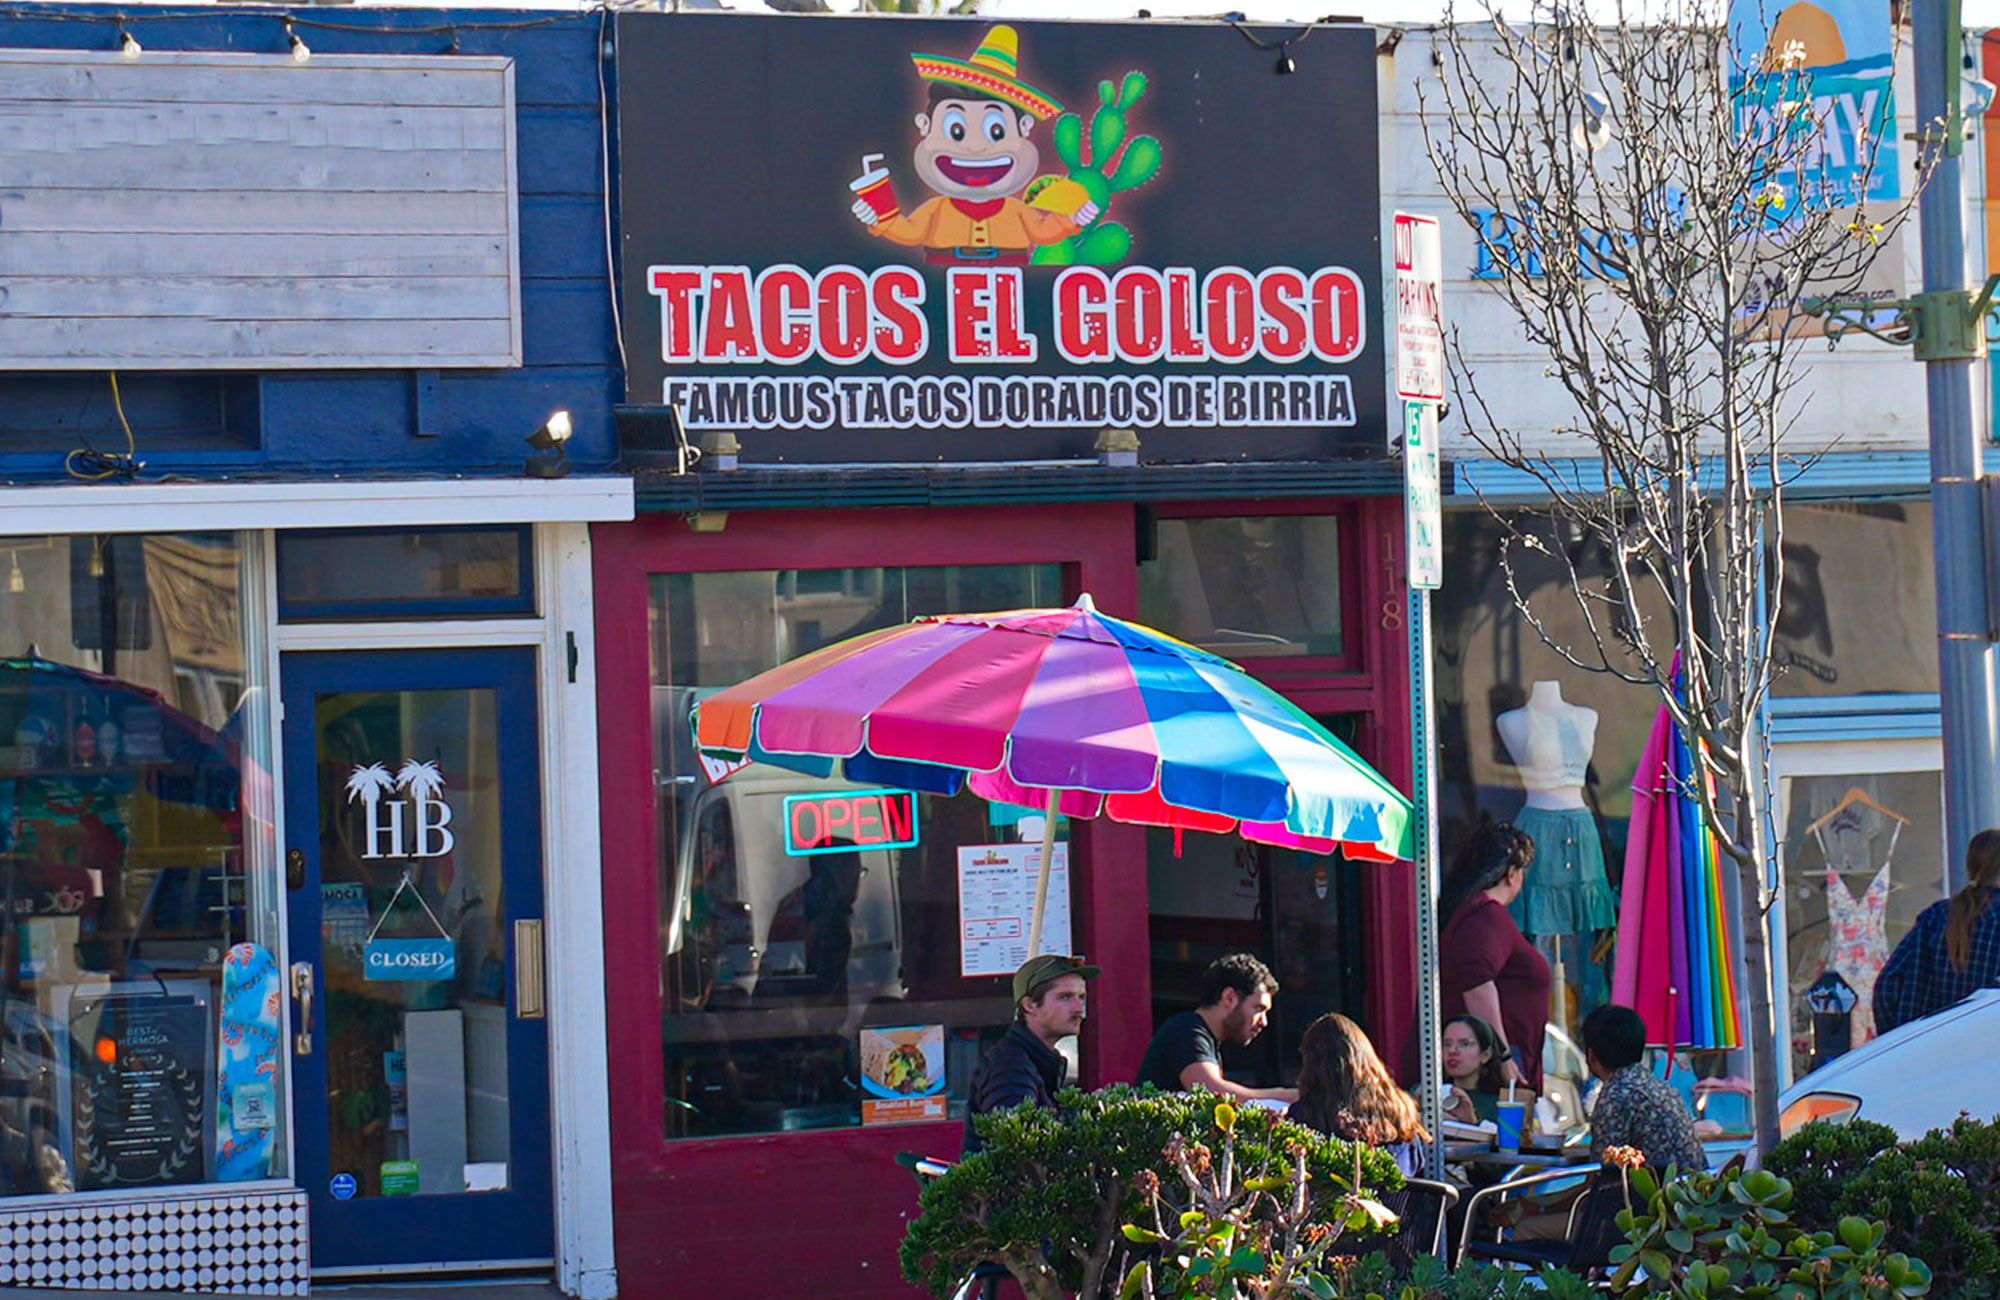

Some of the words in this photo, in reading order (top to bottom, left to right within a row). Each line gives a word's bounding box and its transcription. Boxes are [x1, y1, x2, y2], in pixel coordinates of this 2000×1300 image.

[1396, 221, 1412, 264] NO
[650, 266, 927, 363] TACOS
[948, 267, 1036, 362] EL
[1055, 267, 1364, 362] GOLOSO
[665, 379, 835, 427] FAMOUS
[838, 379, 972, 427] TACOS
[977, 378, 1160, 426] DORADOS
[1166, 378, 1214, 424] DE
[1221, 378, 1353, 424] BIRRIA
[353, 780, 455, 859] HB
[791, 794, 912, 849] OPEN
[369, 951, 446, 967] CLOSED
